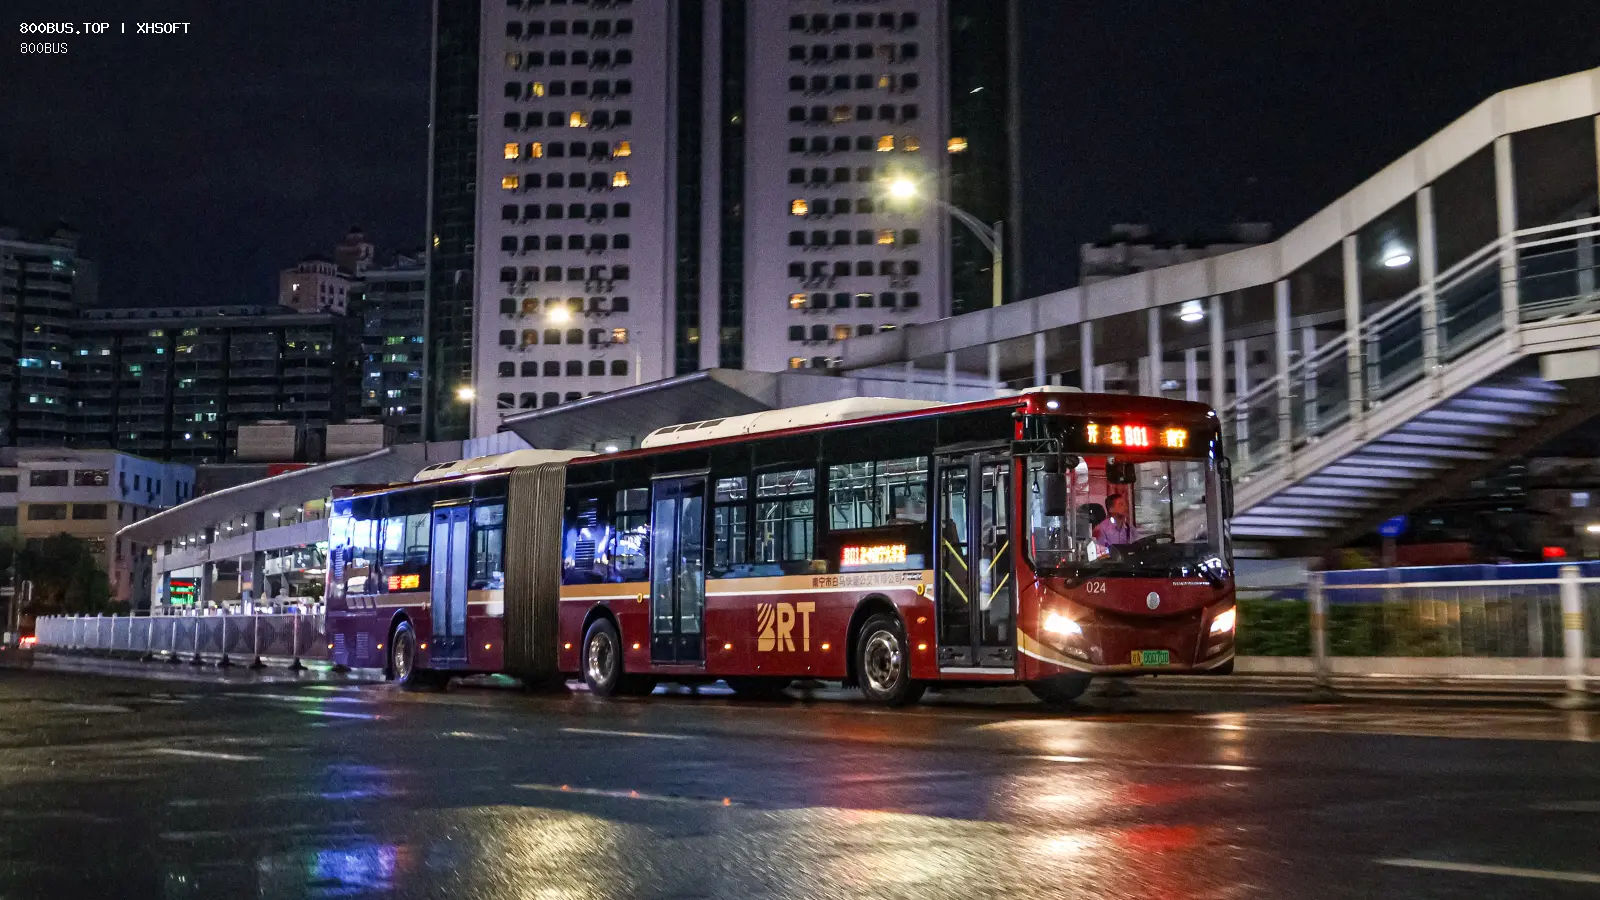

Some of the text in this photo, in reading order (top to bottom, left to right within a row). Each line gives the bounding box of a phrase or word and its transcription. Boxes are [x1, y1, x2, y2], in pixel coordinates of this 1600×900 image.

[1124, 425, 1148, 446] B01
[1086, 581, 1106, 594] 024
[757, 601, 816, 652] BRT
